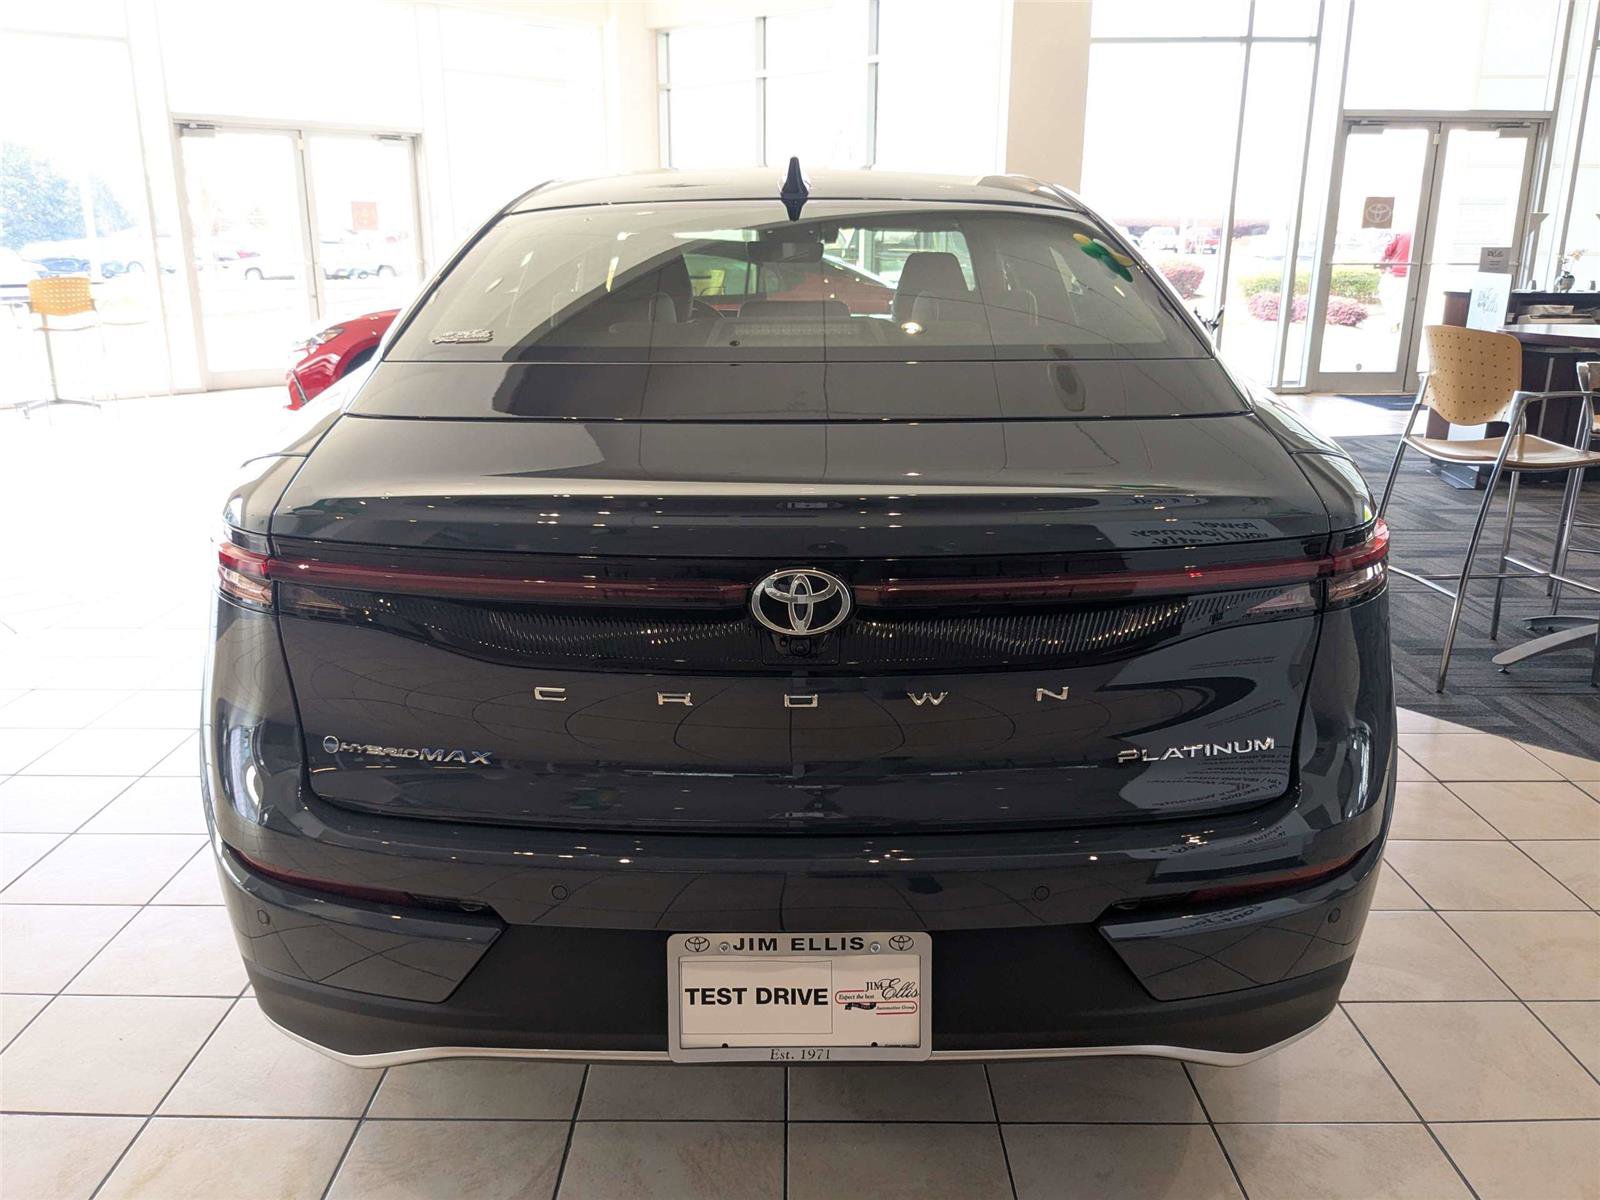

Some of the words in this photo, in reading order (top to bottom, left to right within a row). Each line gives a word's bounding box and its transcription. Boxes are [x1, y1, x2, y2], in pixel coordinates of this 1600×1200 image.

[534, 686, 1070, 708] CROWN
[1117, 737, 1275, 764] PLATINUM
[733, 937, 778, 952] JIM
[791, 937, 865, 951] ELLIS
[685, 987, 748, 1005] TEST
[756, 987, 829, 1005] DRIVE
[865, 982, 883, 992] JIM
[880, 978, 920, 1000] Ellis
[770, 1049, 794, 1061] Est.
[801, 1048, 831, 1061] 1971
